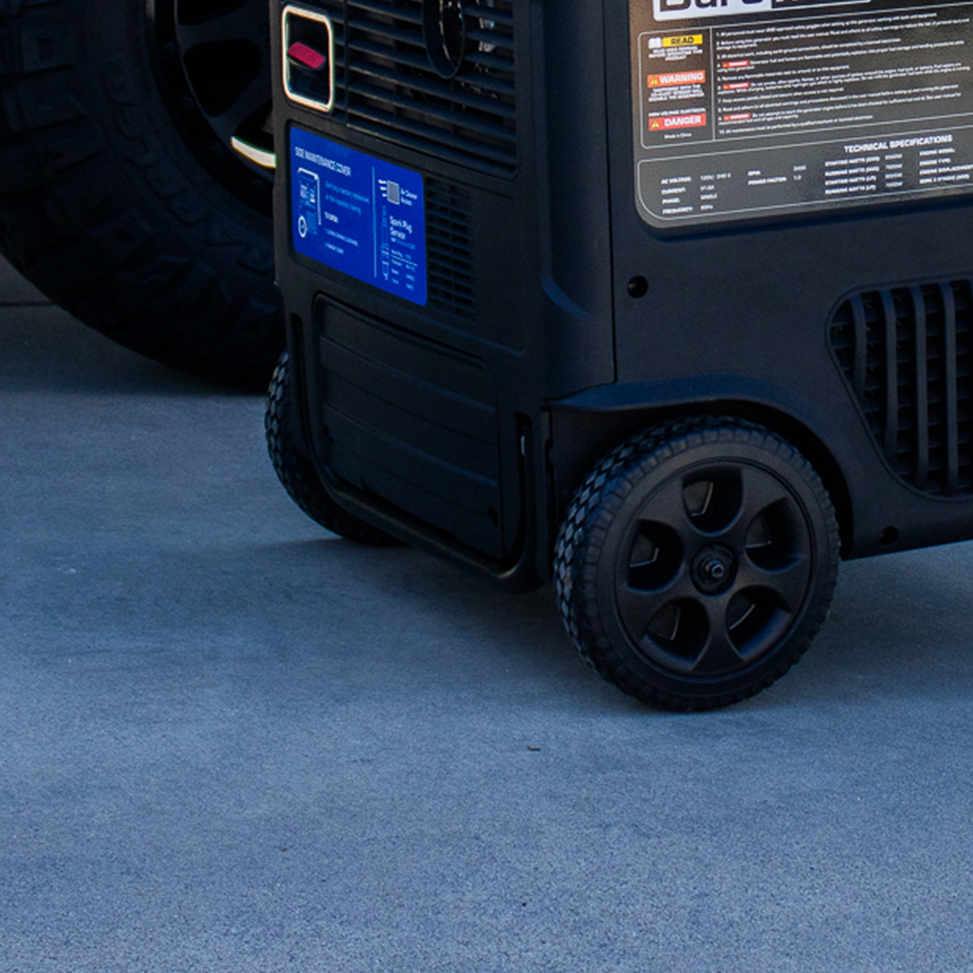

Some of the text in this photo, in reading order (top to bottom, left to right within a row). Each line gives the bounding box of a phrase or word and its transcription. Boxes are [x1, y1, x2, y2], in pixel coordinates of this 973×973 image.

[670, 36, 695, 45] READ
[660, 72, 703, 84] WARNING
[664, 116, 701, 127] DANGER
[844, 134, 953, 153] TECHNICAL SPECIFICATIONS
